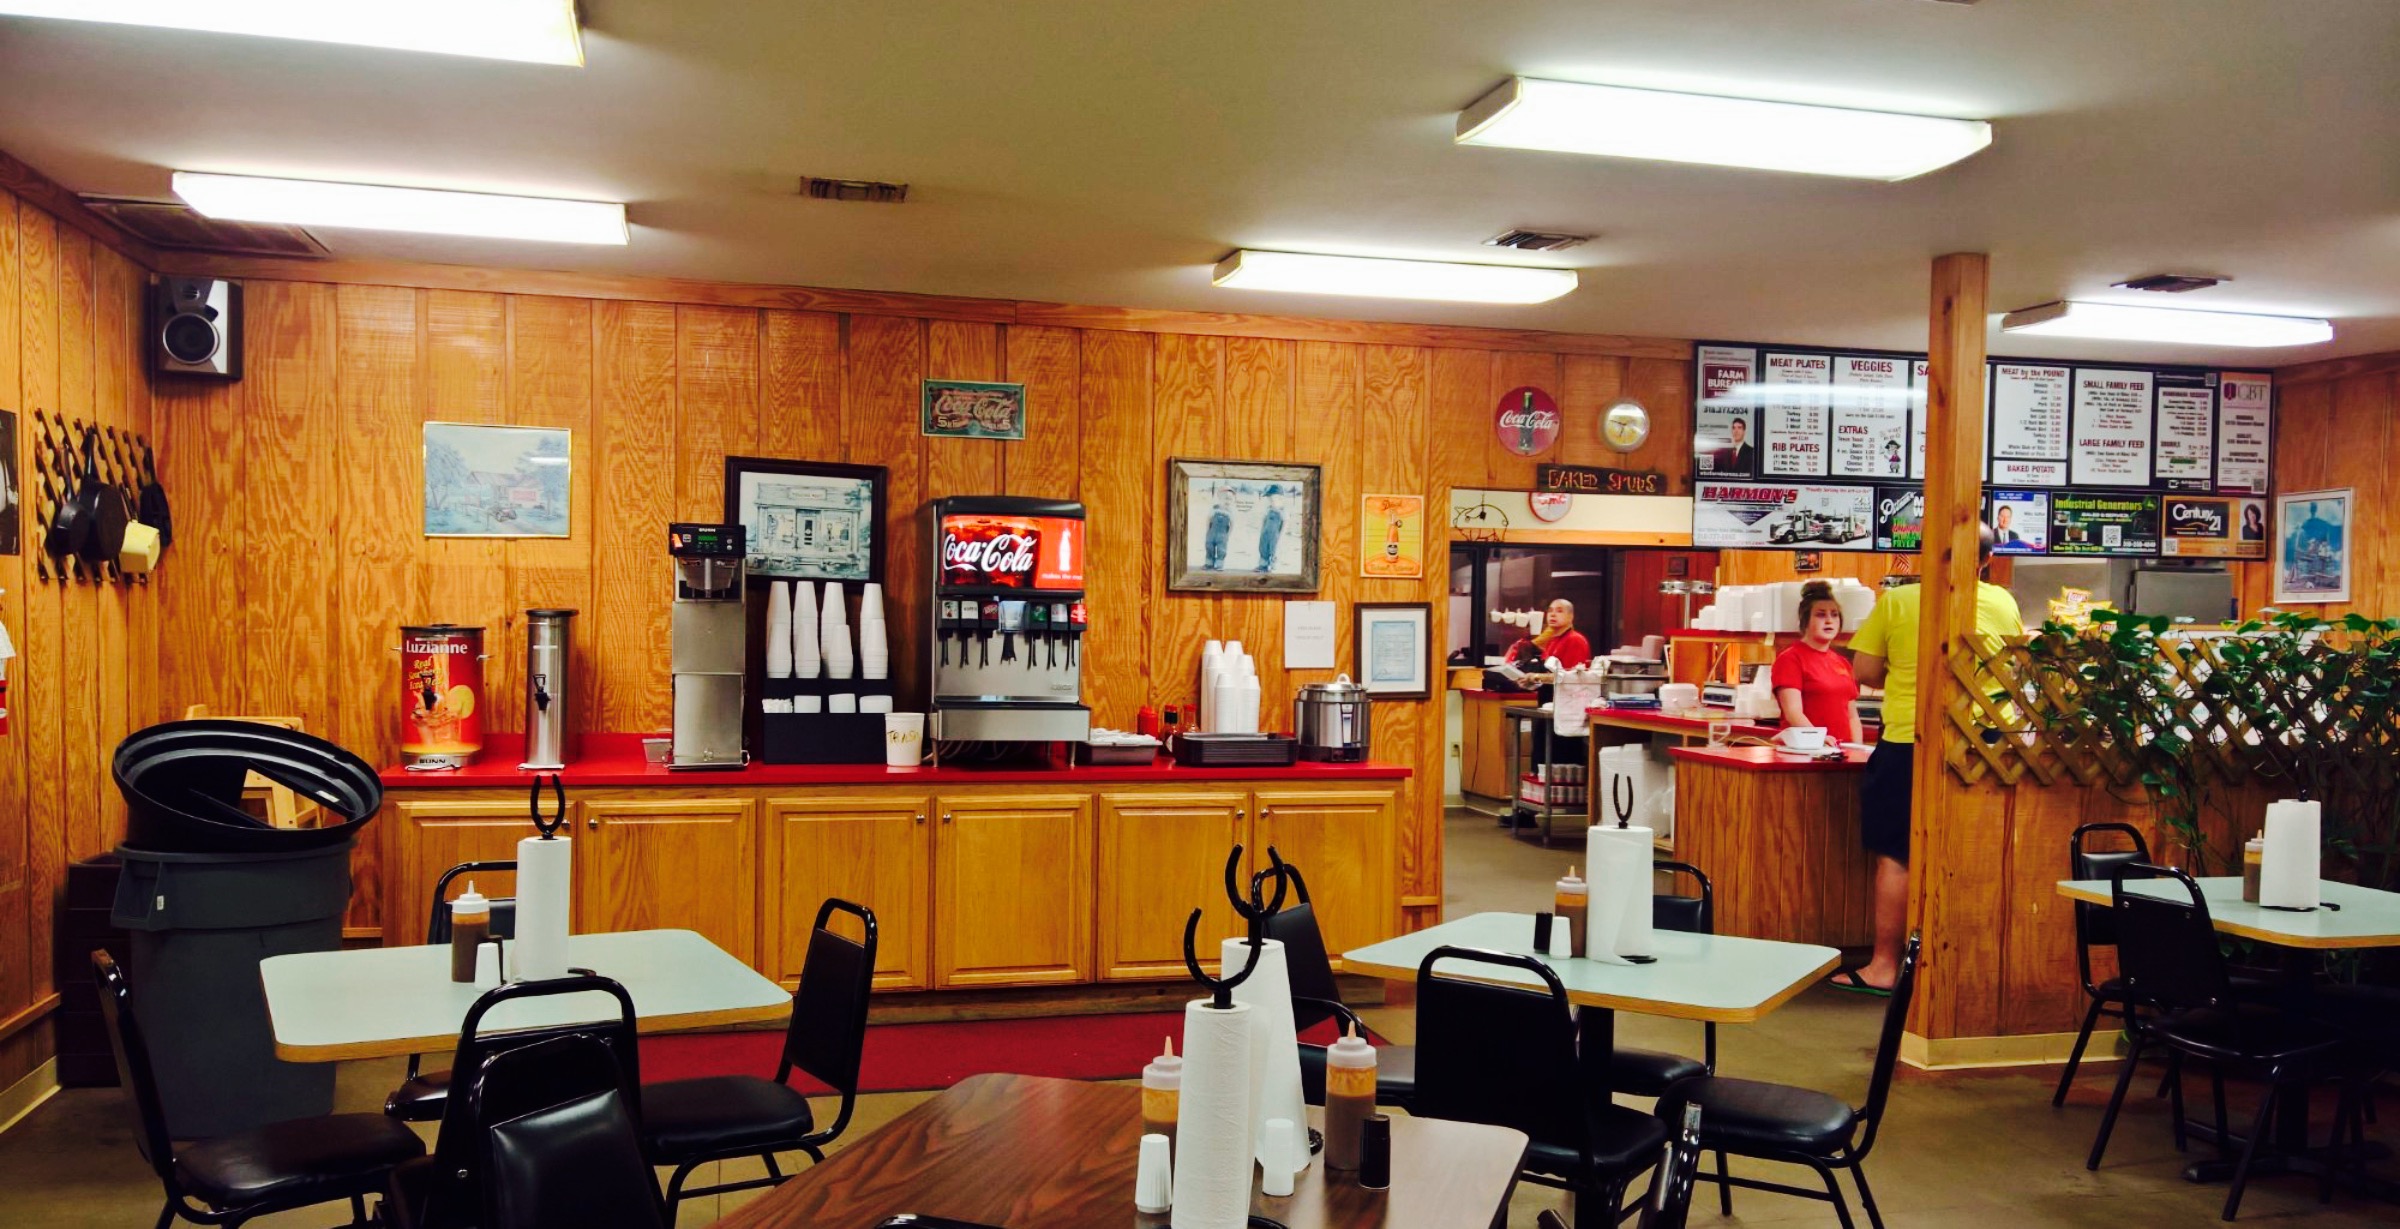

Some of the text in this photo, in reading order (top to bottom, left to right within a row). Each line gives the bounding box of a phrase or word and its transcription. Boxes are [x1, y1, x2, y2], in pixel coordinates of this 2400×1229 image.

[1770, 358, 1826, 369] MEAT PLATES
[1850, 360, 1893, 373] VEGGIES
[1718, 370, 1745, 380] FARM
[2083, 380, 2144, 390] SMALL FAMILY FEED
[1500, 409, 1557, 430] Coca-Cola
[1838, 425, 1868, 435] EXTRAS
[1772, 442, 1820, 453] RIB PLATES
[2079, 439, 2144, 449] LARGE FAMILY FEED
[2031, 465, 2055, 473] POTATO
[1701, 486, 1799, 504] HARMON'S
[2054, 498, 2143, 511] Industrial Generators
[2172, 503, 2214, 522] Century
[2208, 515, 2222, 531] 21
[942, 533, 1037, 573] Coca-Cola
[406, 640, 468, 655] Luzianne
